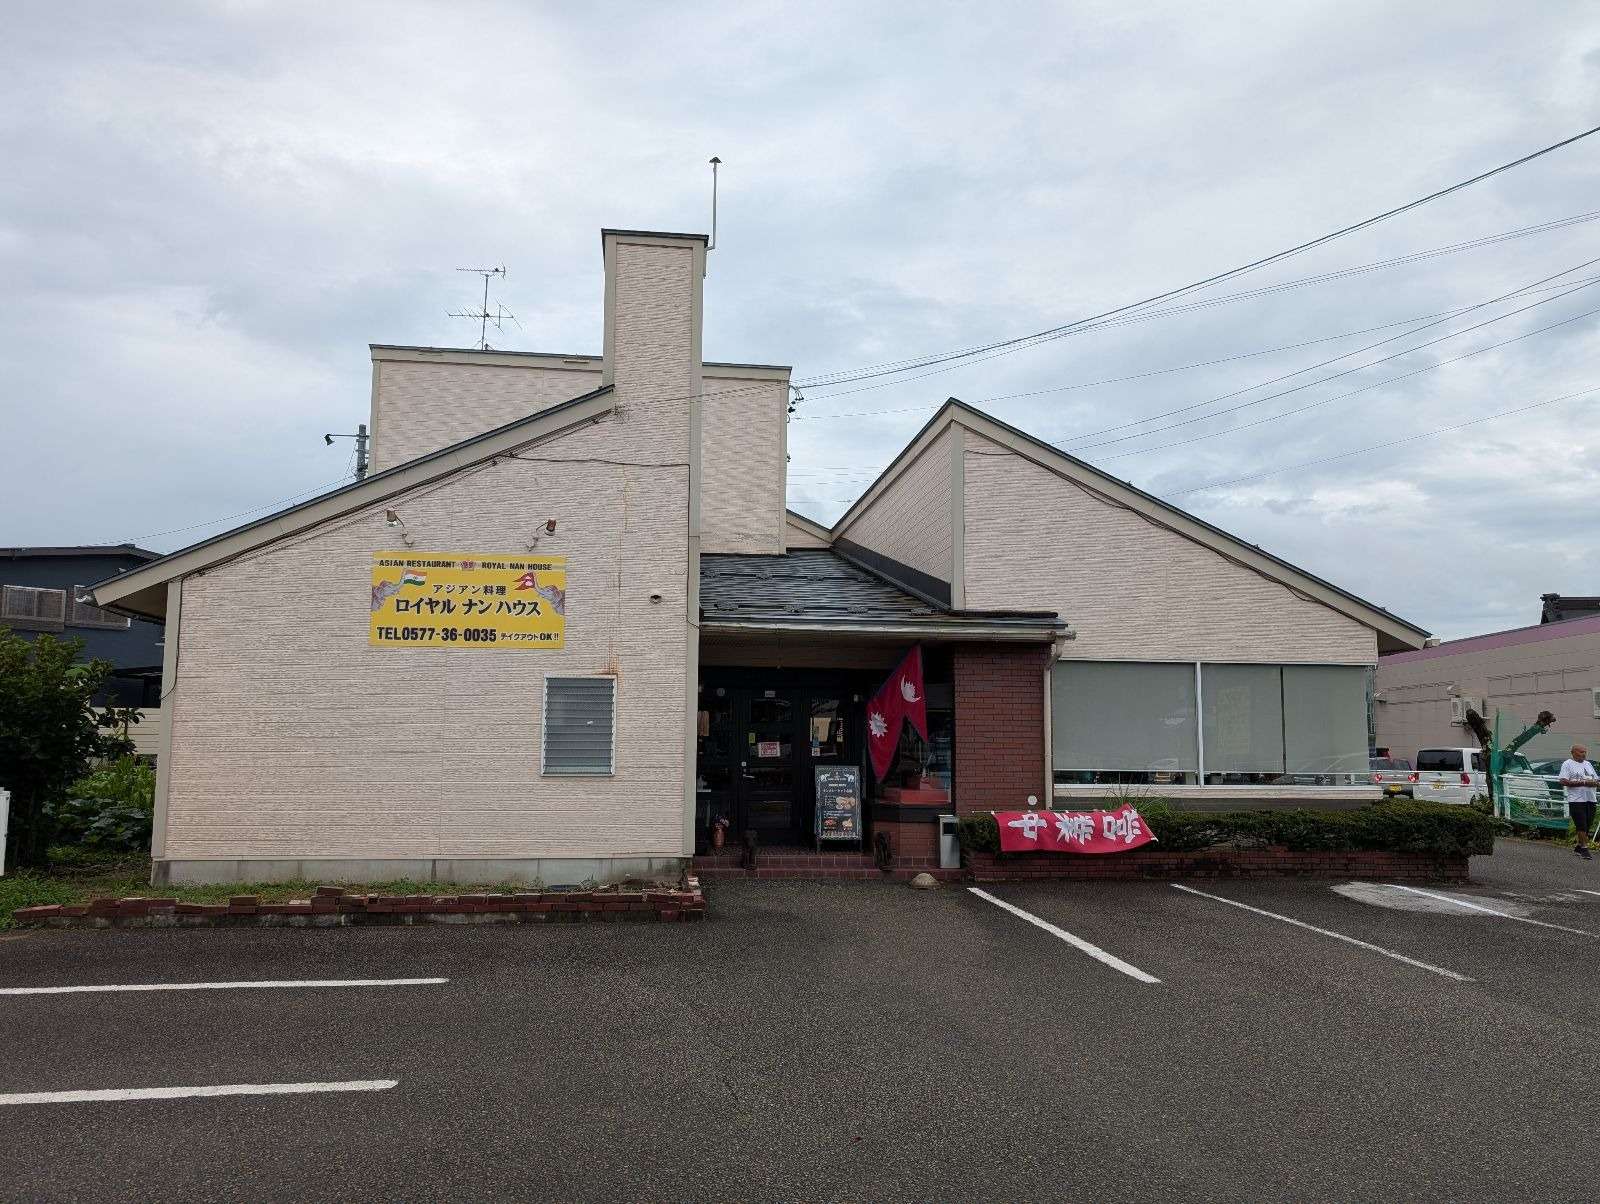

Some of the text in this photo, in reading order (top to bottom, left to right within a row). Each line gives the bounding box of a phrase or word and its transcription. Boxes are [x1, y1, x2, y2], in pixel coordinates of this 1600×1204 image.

[379, 559, 456, 568] ASIAN RESTAURANT
[481, 562, 552, 571] ROYAL NAN HOUSE
[433, 584, 507, 596] アジアン料理
[395, 598, 542, 616] ロイヤル ナン ハウス
[377, 627, 497, 642] TEL0577-36-0035
[1007, 809, 1142, 846] 営業中
